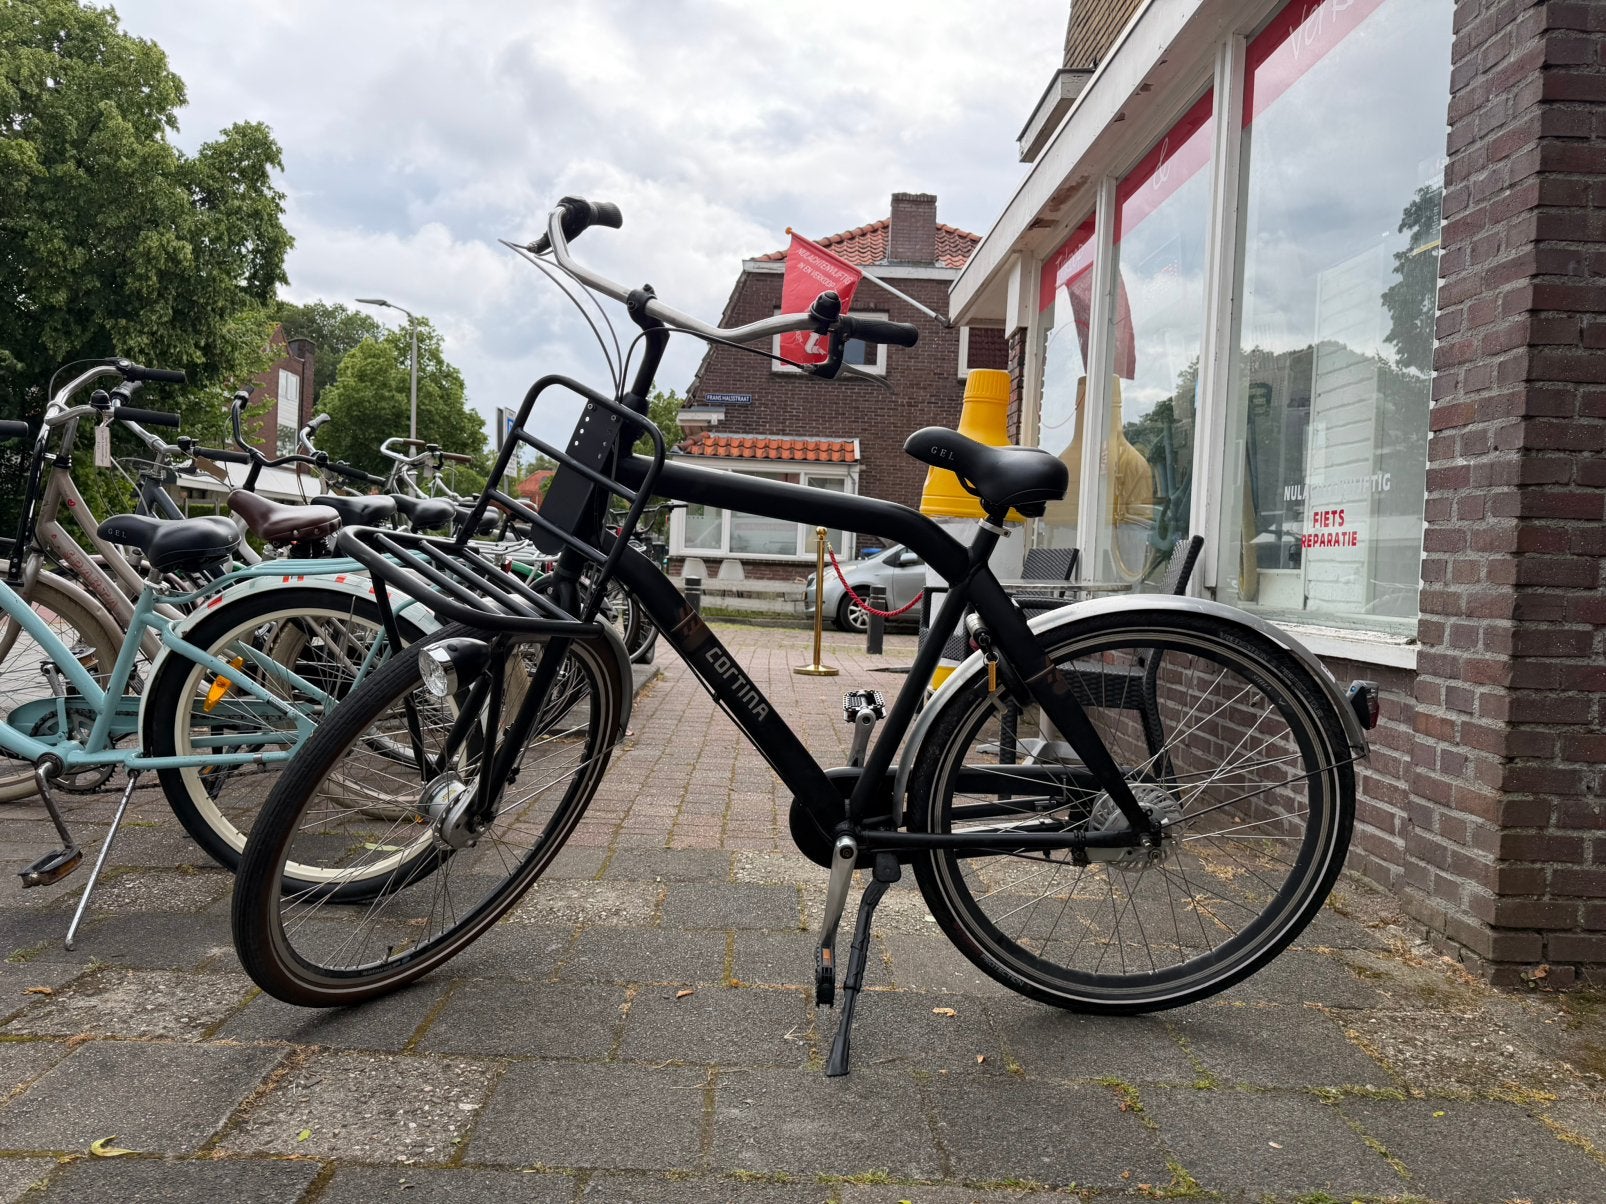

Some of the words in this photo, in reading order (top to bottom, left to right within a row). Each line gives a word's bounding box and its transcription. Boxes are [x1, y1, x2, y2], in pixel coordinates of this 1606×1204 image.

[930, 446, 955, 461] GEL
[1313, 509, 1345, 528] FIETS
[107, 527, 127, 539] GEL
[1301, 531, 1358, 548] REPARATIE
[62, 549, 119, 610] SPARTA
